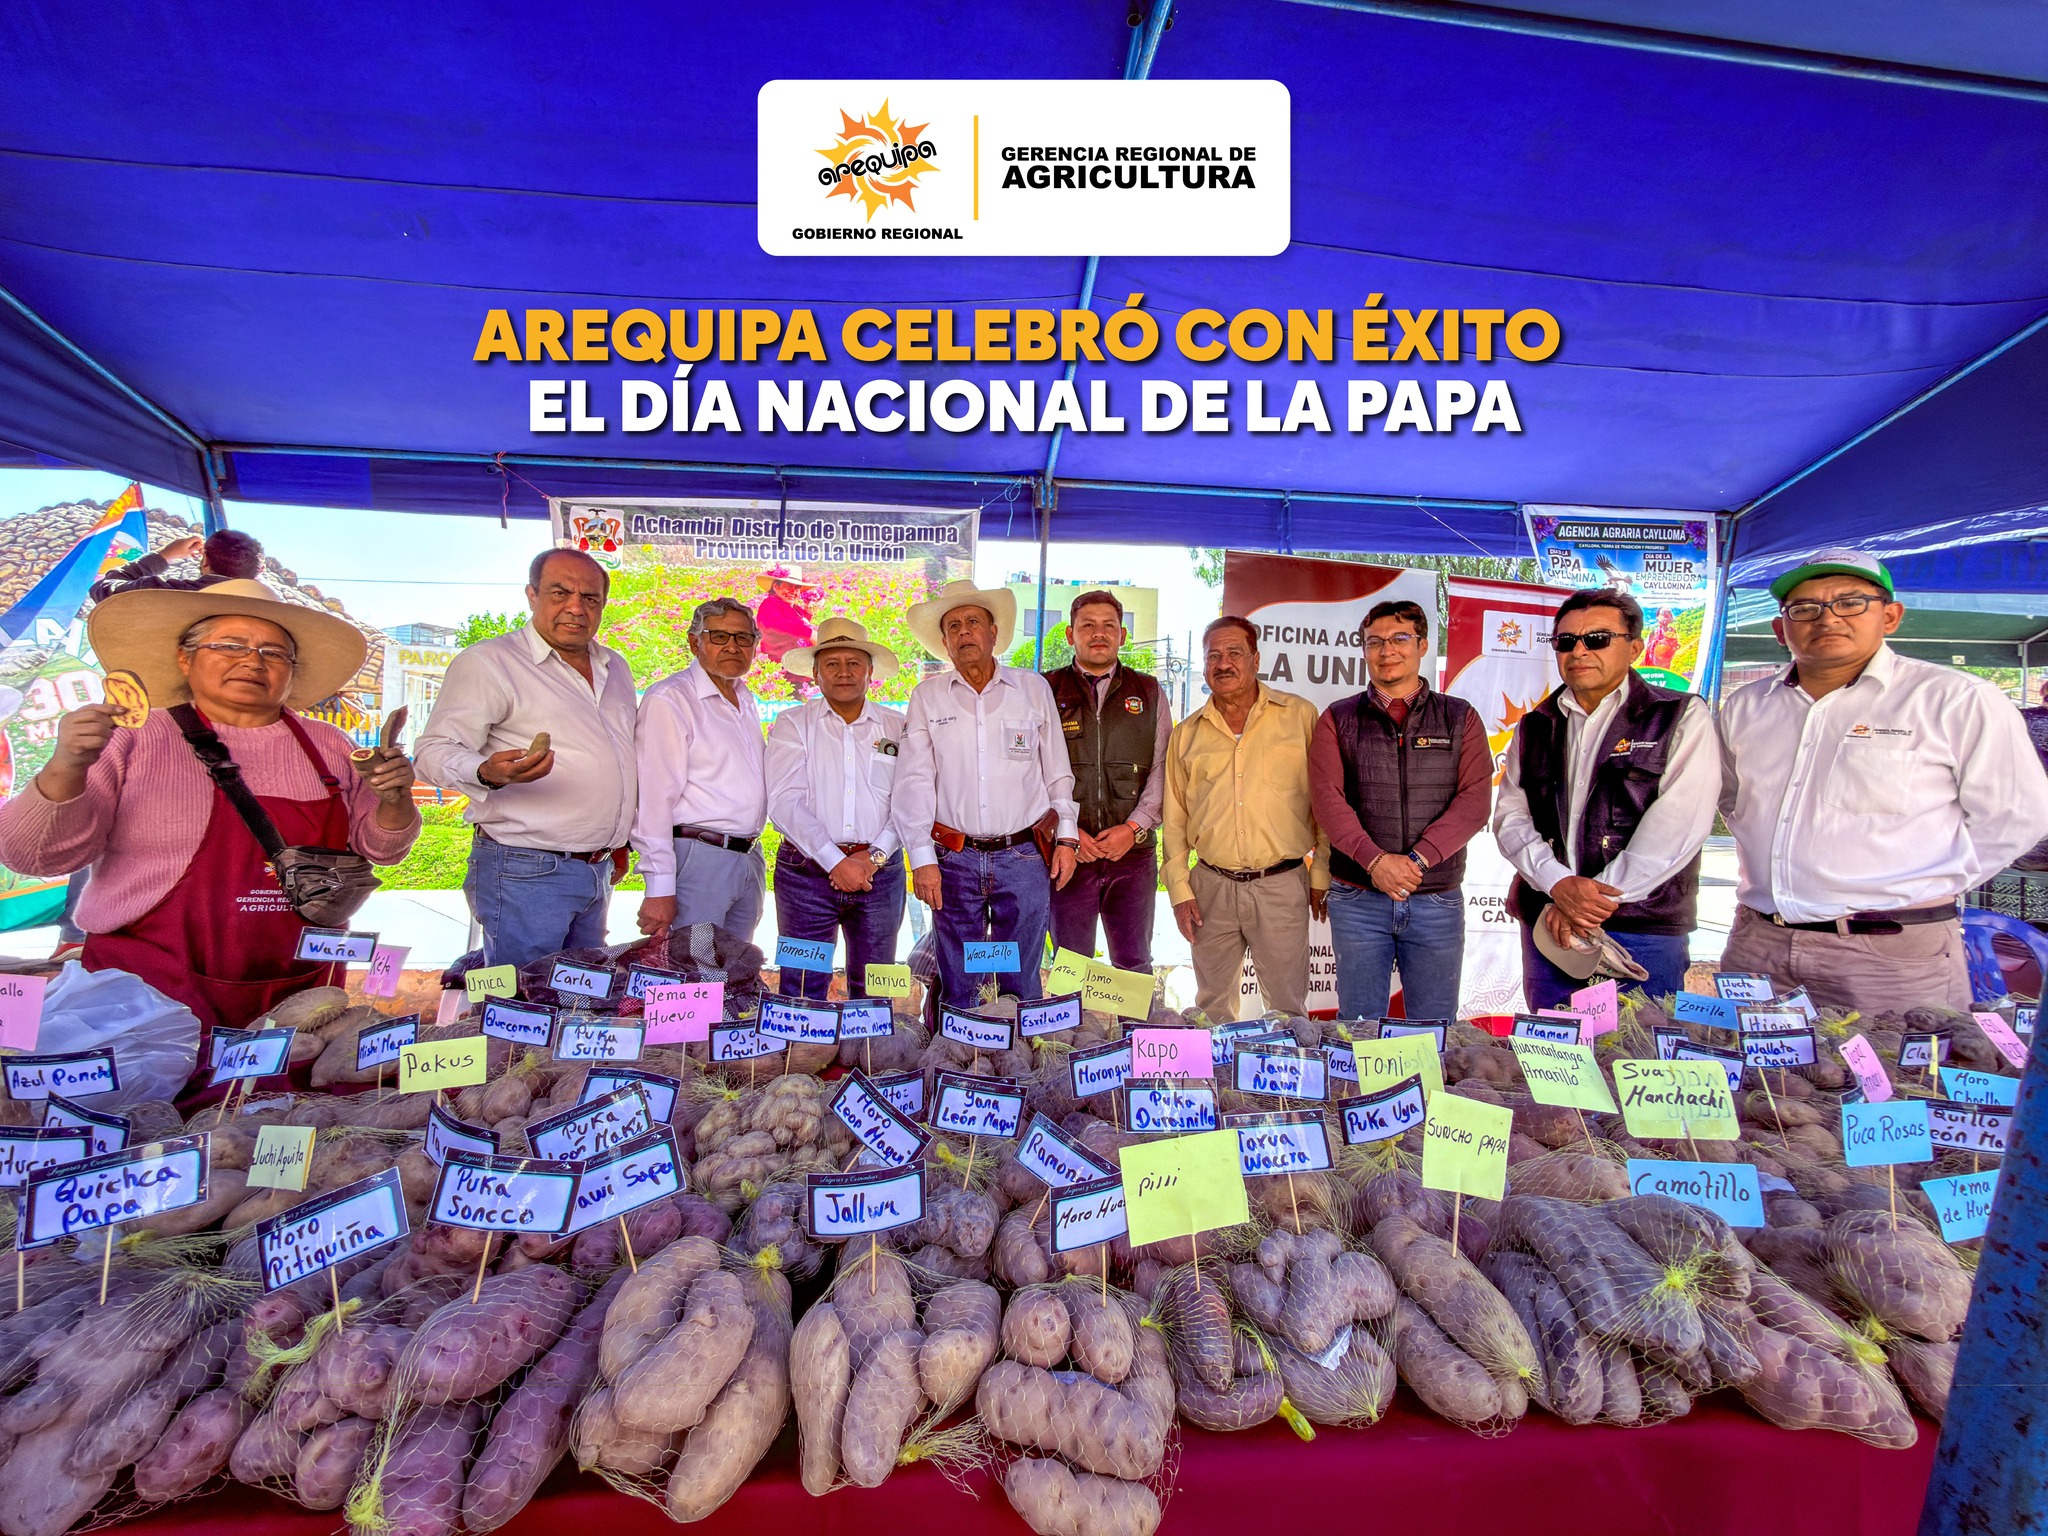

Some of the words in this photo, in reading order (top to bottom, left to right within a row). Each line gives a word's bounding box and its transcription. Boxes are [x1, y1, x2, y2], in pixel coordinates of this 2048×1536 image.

[632, 514, 724, 538] Achambi
[731, 516, 807, 540] Distrito
[810, 518, 835, 540] de
[839, 520, 959, 544] Tomepampa
[1558, 525, 1599, 538] AGENCIA
[1602, 527, 1642, 539] AGRARIA
[1643, 529, 1686, 540] CAYLLOMA
[695, 537, 789, 561] Provincia
[793, 540, 820, 561] de
[824, 541, 845, 561] La
[849, 539, 906, 562] Unión
[1635, 572, 1703, 582] EMPRENDEDORA
[1645, 561, 1693, 573] MUJER
[1643, 581, 1693, 590] CAYLLOMINA
[1335, 631, 1363, 648] AG
[1307, 654, 1367, 686] UNI
[19, 670, 106, 721] 30
[1469, 896, 1507, 906] AGEN
[309, 942, 357, 957] Waña
[778, 941, 826, 961] Tomasita
[467, 974, 506, 992] Unica
[554, 969, 594, 989] Carla
[867, 972, 909, 988] Mariva
[0, 983, 23, 997] allo
[646, 987, 687, 1005] Yema
[694, 987, 709, 999] de
[648, 1009, 695, 1028] Huevo
[1677, 1000, 1725, 1017] Zorrilla
[1136, 1037, 1178, 1068] Kapo
[403, 1053, 474, 1078] Pakus
[1358, 1051, 1404, 1077] Toni
[1522, 1060, 1579, 1086] Amarillo
[13, 1069, 46, 1089] Azul
[1955, 1072, 1990, 1087] Moro
[1625, 1085, 1725, 1109] Manchachi
[562, 1111, 620, 1140] Puka
[1846, 1115, 1875, 1150] Puca
[1879, 1116, 1925, 1143] Rosas
[1930, 1126, 1967, 1143] eón
[55, 1166, 182, 1203] Quichca
[457, 1166, 512, 1198] Puka
[1635, 1171, 1750, 1201] Camotillo
[1947, 1178, 1991, 1197] Yema
[62, 1198, 143, 1234] Papa
[448, 1195, 534, 1225] Soncco
[1056, 1208, 1092, 1230] Moro
[1943, 1207, 1962, 1223] de
[270, 1217, 320, 1250] Moro
